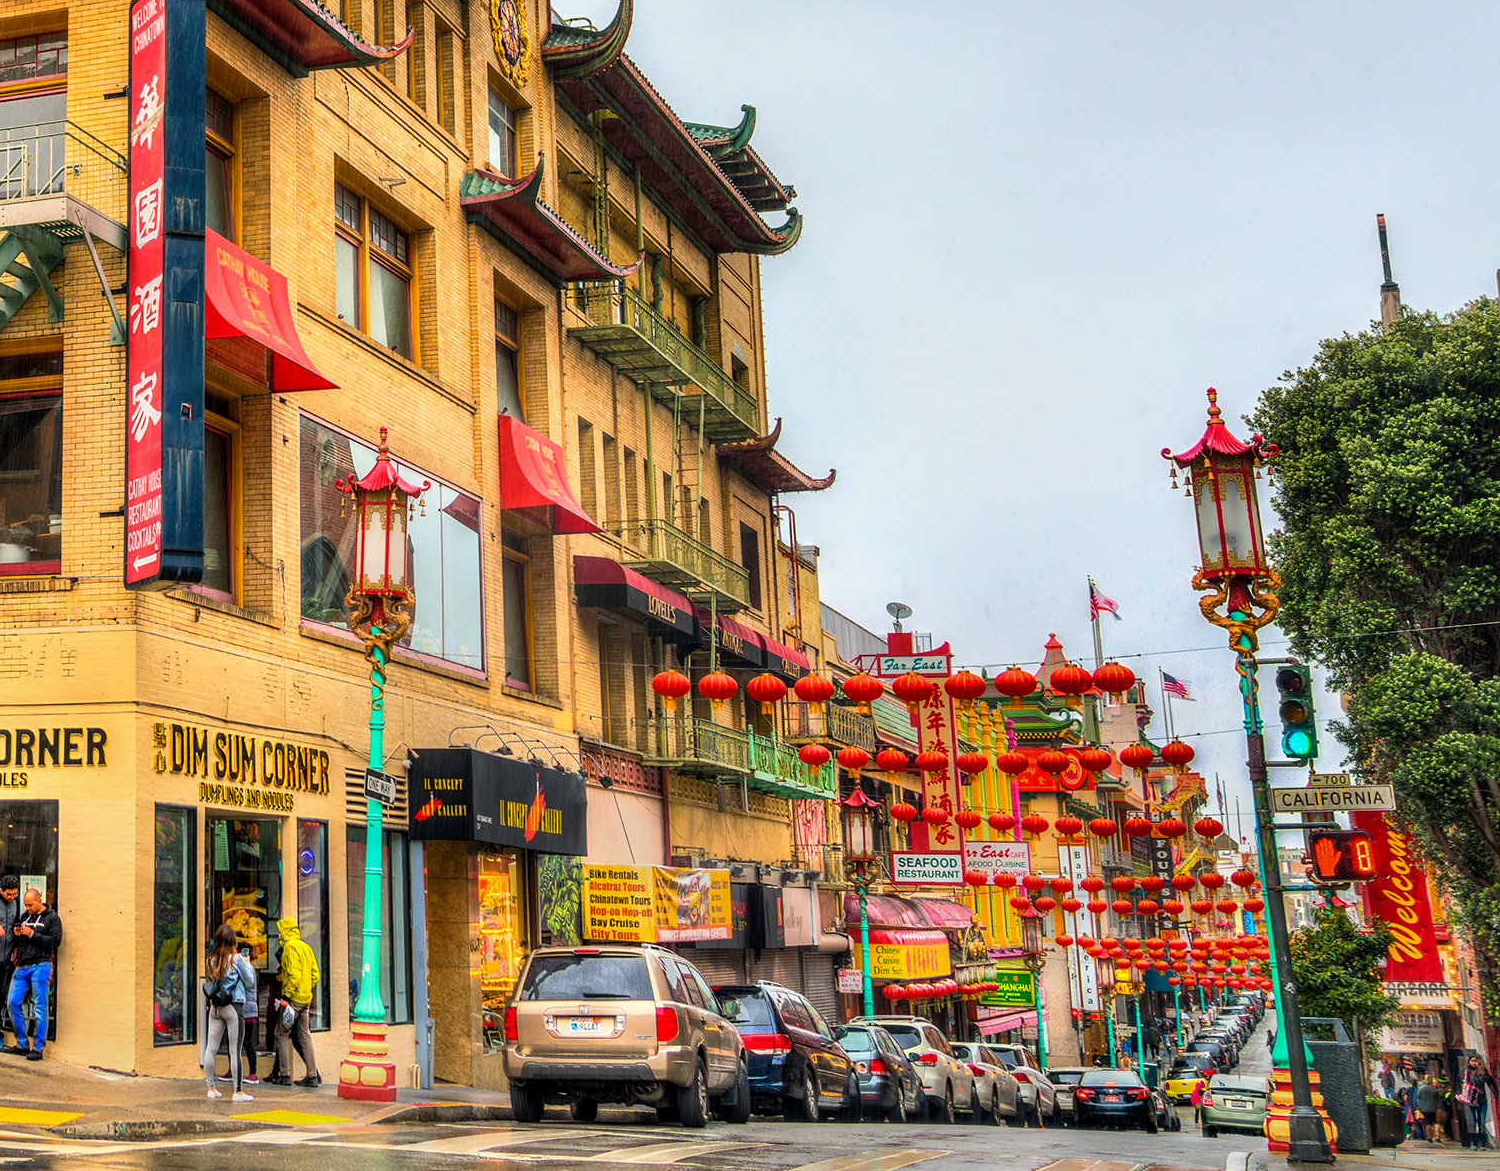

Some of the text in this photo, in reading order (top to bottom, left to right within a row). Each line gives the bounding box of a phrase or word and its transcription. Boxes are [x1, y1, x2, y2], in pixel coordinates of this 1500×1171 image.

[134, 14, 165, 54] CHINATOWN
[217, 247, 270, 294] CATHAY HOUSE
[128, 468, 162, 501] CATHAY HOUSE
[128, 495, 162, 527] RESTAURANT
[127, 527, 157, 553] COCKTAILS
[884, 658, 943, 672] Far East
[169, 723, 330, 795] DIM SUM CORNER
[369, 777, 391, 794] ONE WAY
[424, 778, 463, 790] IL CONCEPT
[1325, 775, 1346, 785] 700
[199, 782, 294, 811] DUMPLINGS AND NOODLES
[1282, 791, 1385, 807] CALIFORNIA
[437, 805, 467, 817] GALLERY
[499, 800, 506, 826] IL
[507, 802, 528, 830] CONCEPT
[541, 808, 562, 835] GALLERY
[980, 844, 1010, 858] East
[898, 857, 958, 868] SEAFOOD
[995, 859, 1026, 868] CUISINE
[1156, 839, 1170, 881] FOUR
[589, 869, 638, 880] Bike Rentals
[897, 869, 960, 879] RESTAURANT
[1074, 851, 1084, 891] Bank
[590, 881, 646, 893] Alcatraz Tours
[1382, 822, 1424, 963] Welcom
[590, 894, 651, 905] Chinatown Tours
[590, 906, 653, 918] Hop-on Hop-off
[591, 917, 639, 929] Bay Cruise
[591, 929, 639, 940] City Tours
[711, 927, 728, 939] CENTER
[876, 946, 900, 954] Chinese
[877, 956, 900, 964] Cuisine
[874, 966, 890, 975] Dim
[1083, 940, 1094, 1005] erica
